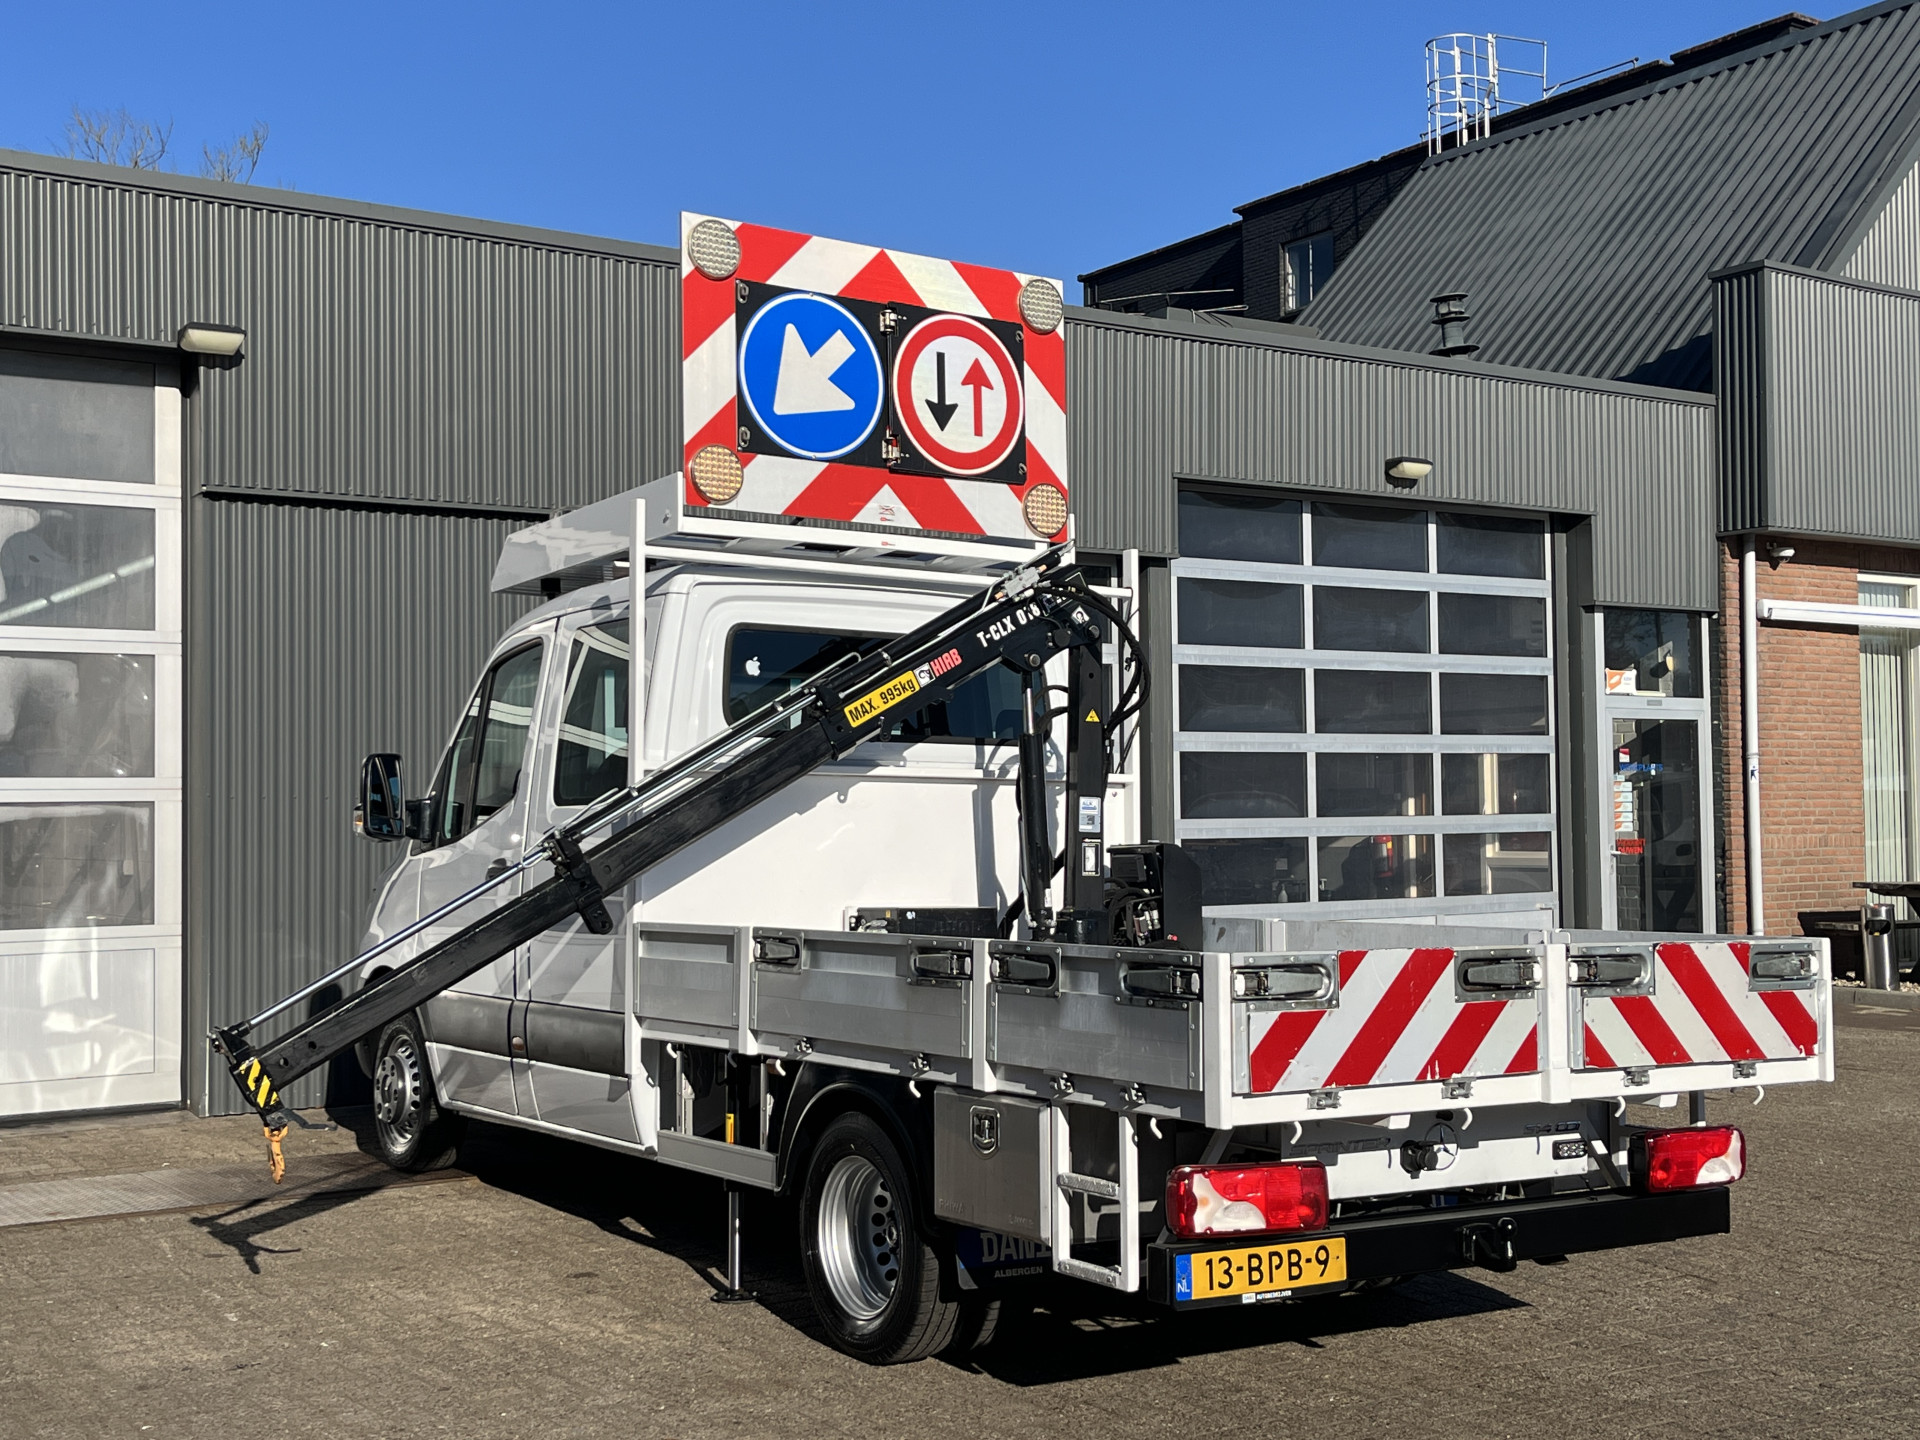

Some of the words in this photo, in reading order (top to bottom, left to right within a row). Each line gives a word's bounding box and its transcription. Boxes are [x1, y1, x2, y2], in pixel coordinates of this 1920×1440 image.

[976, 615, 1016, 648] T-CLX
[848, 698, 880, 723] MAX.
[879, 678, 916, 705] 995kg
[1289, 1137, 1391, 1156] SPRINTER
[994, 1266, 1043, 1278] ALBERGEN
[1206, 1245, 1330, 1291] 13-BPB-9
[1177, 1281, 1190, 1293] NL
